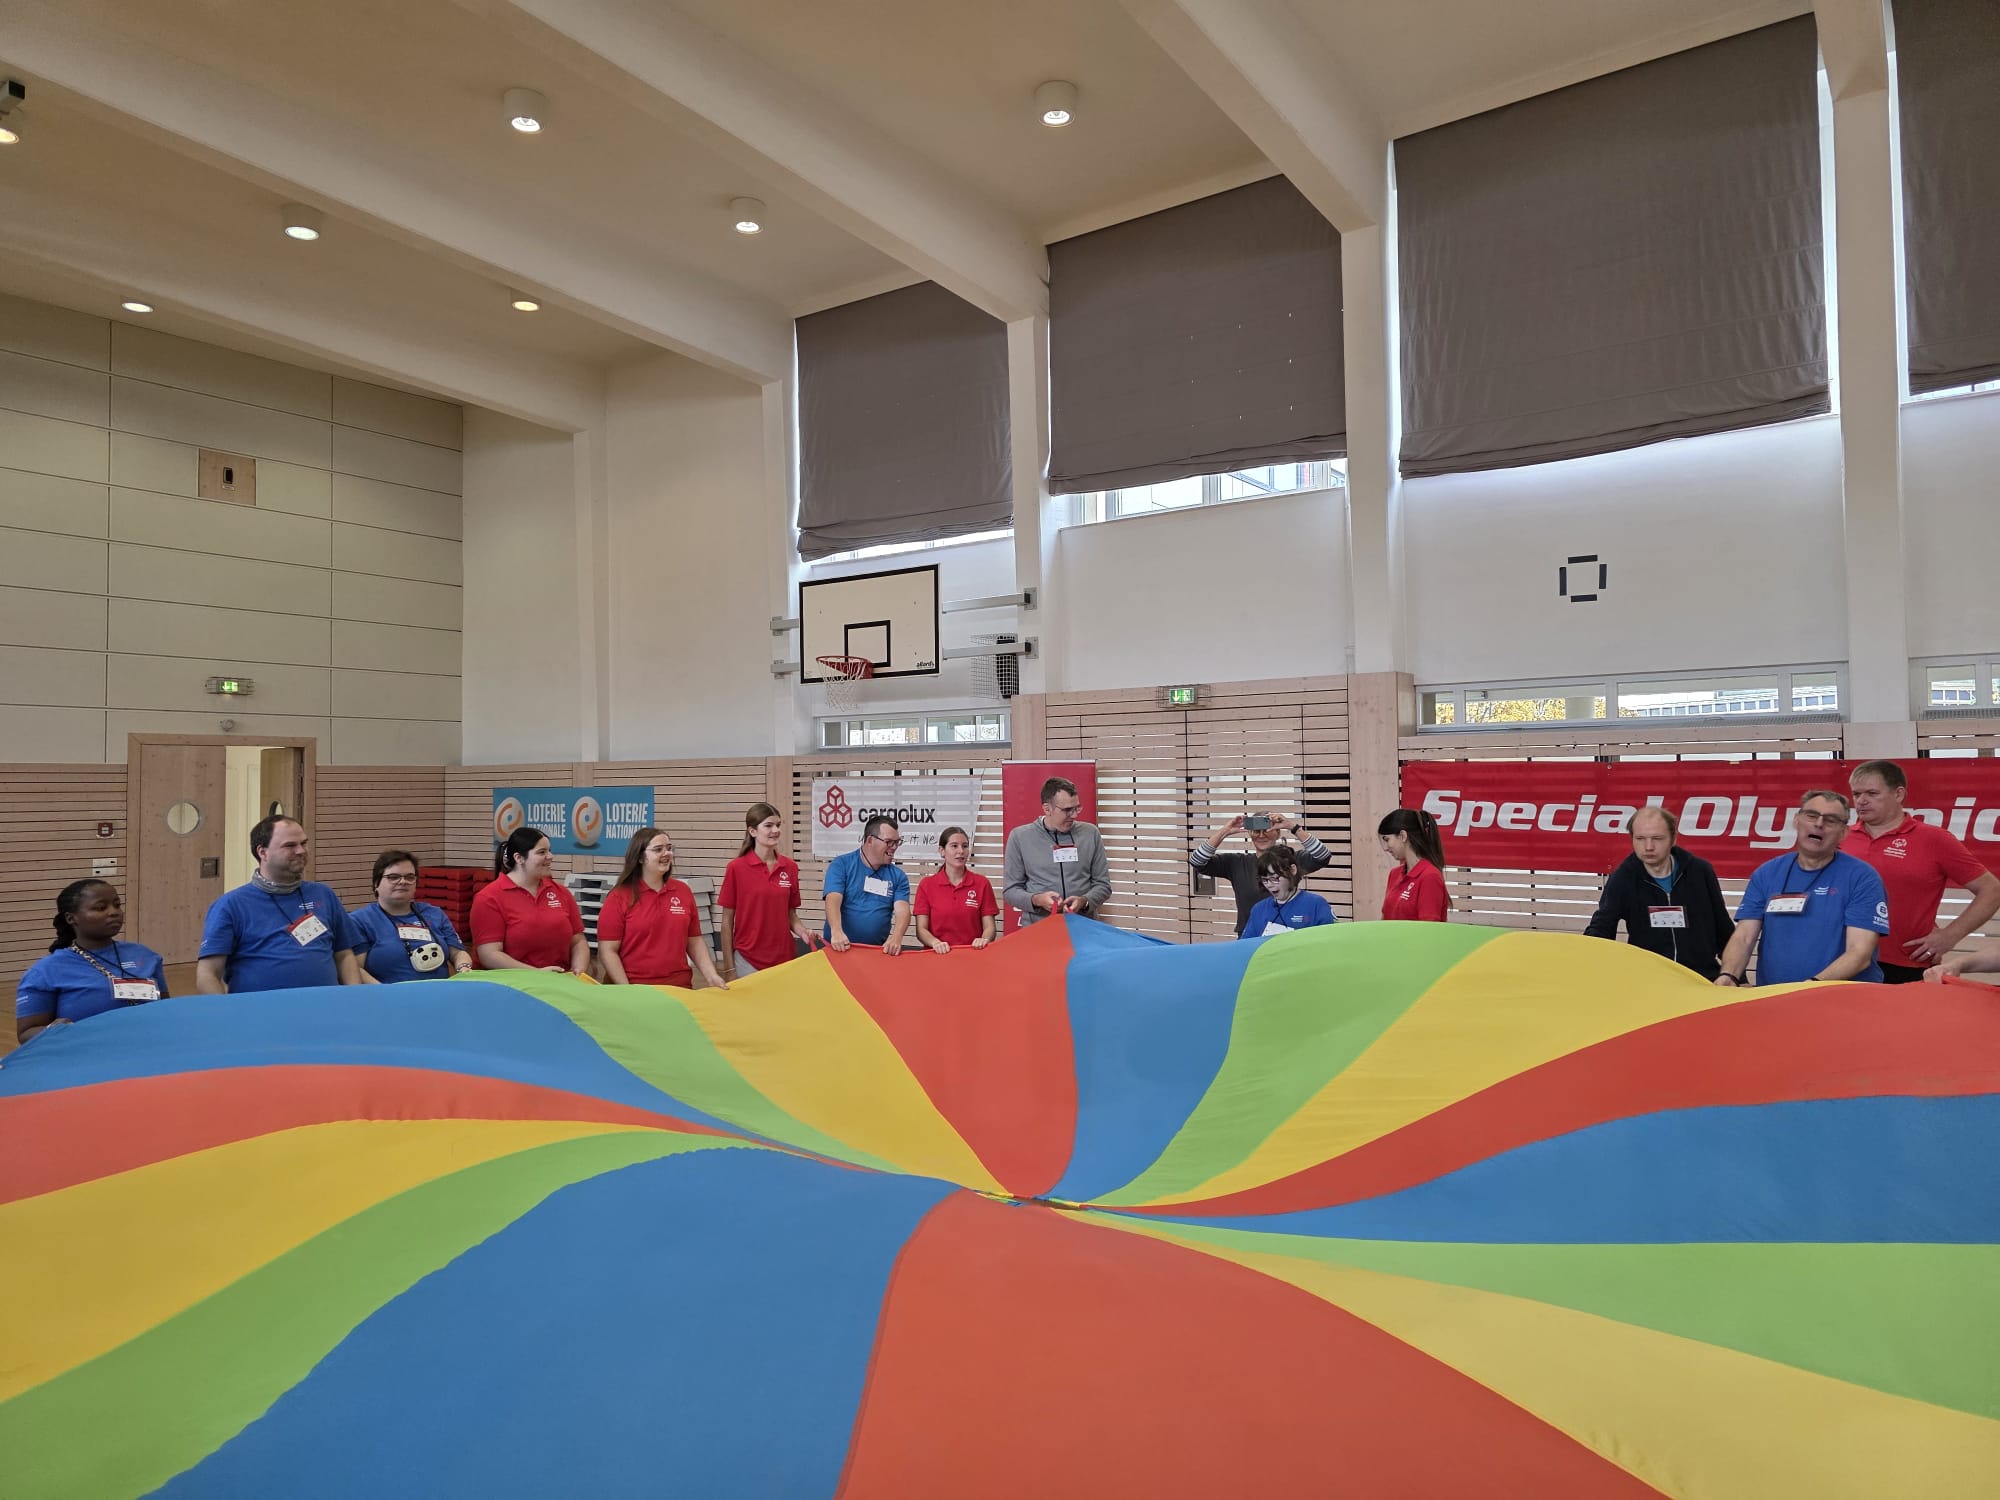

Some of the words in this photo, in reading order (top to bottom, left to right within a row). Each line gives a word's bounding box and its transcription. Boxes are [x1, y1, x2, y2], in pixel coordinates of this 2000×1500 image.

[528, 804, 566, 822] LOTERIE
[606, 803, 649, 822] LOTERIE
[1422, 790, 1664, 836] Specia
